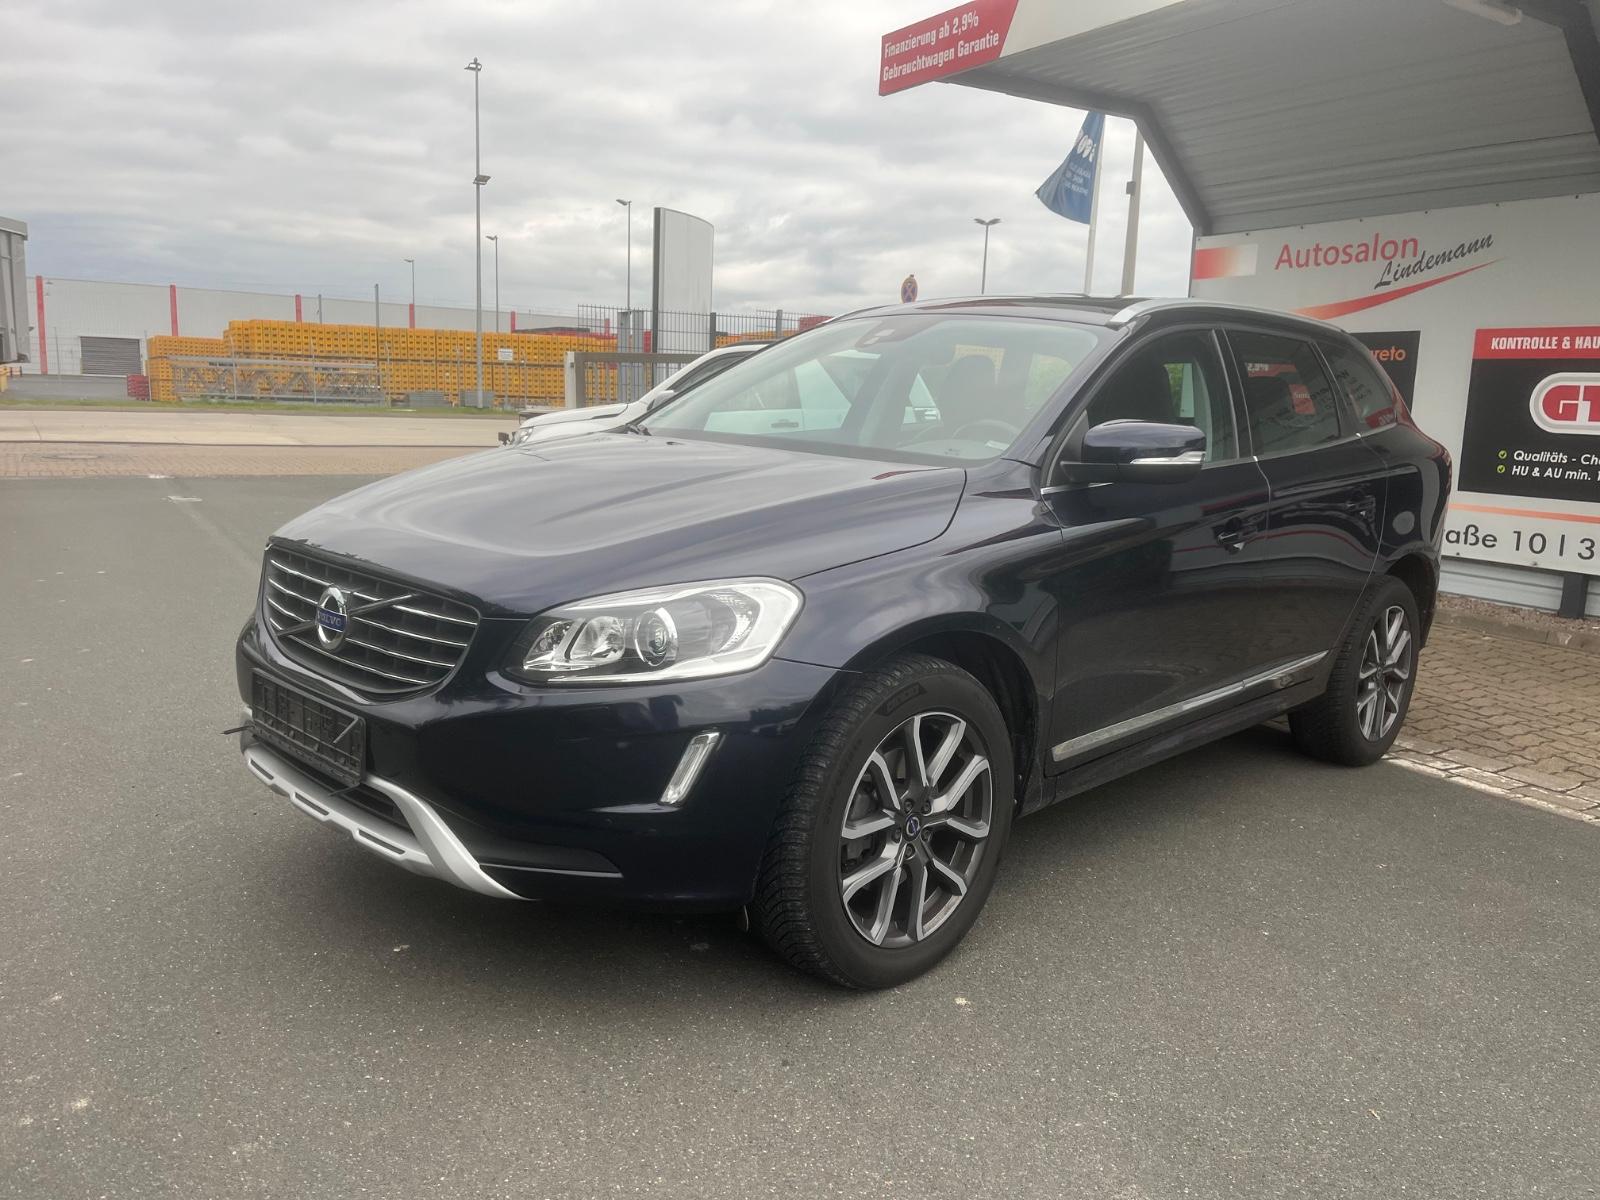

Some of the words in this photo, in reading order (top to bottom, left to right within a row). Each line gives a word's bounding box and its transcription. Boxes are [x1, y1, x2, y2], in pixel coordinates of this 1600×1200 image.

[884, 30, 936, 58] Finanzierung
[938, 22, 950, 40] ab
[952, 11, 979, 36] 2,9%
[883, 48, 955, 81] Gebrauchtwagen
[957, 31, 999, 58] Garantie
[1275, 233, 1418, 270] Autosalon
[1374, 234, 1494, 290] Lindemann
[1491, 336, 1559, 350] KONTROLLE
[1561, 336, 1571, 349] &
[1511, 465, 1529, 476] HU
[1531, 466, 1540, 477] &
[1543, 467, 1562, 479] AU
[1564, 469, 1591, 481] min.
[1513, 449, 1568, 464] Qualitäts
[1444, 524, 1498, 549] aße
[1512, 530, 1547, 555] 10
[1577, 537, 1596, 561] 3
